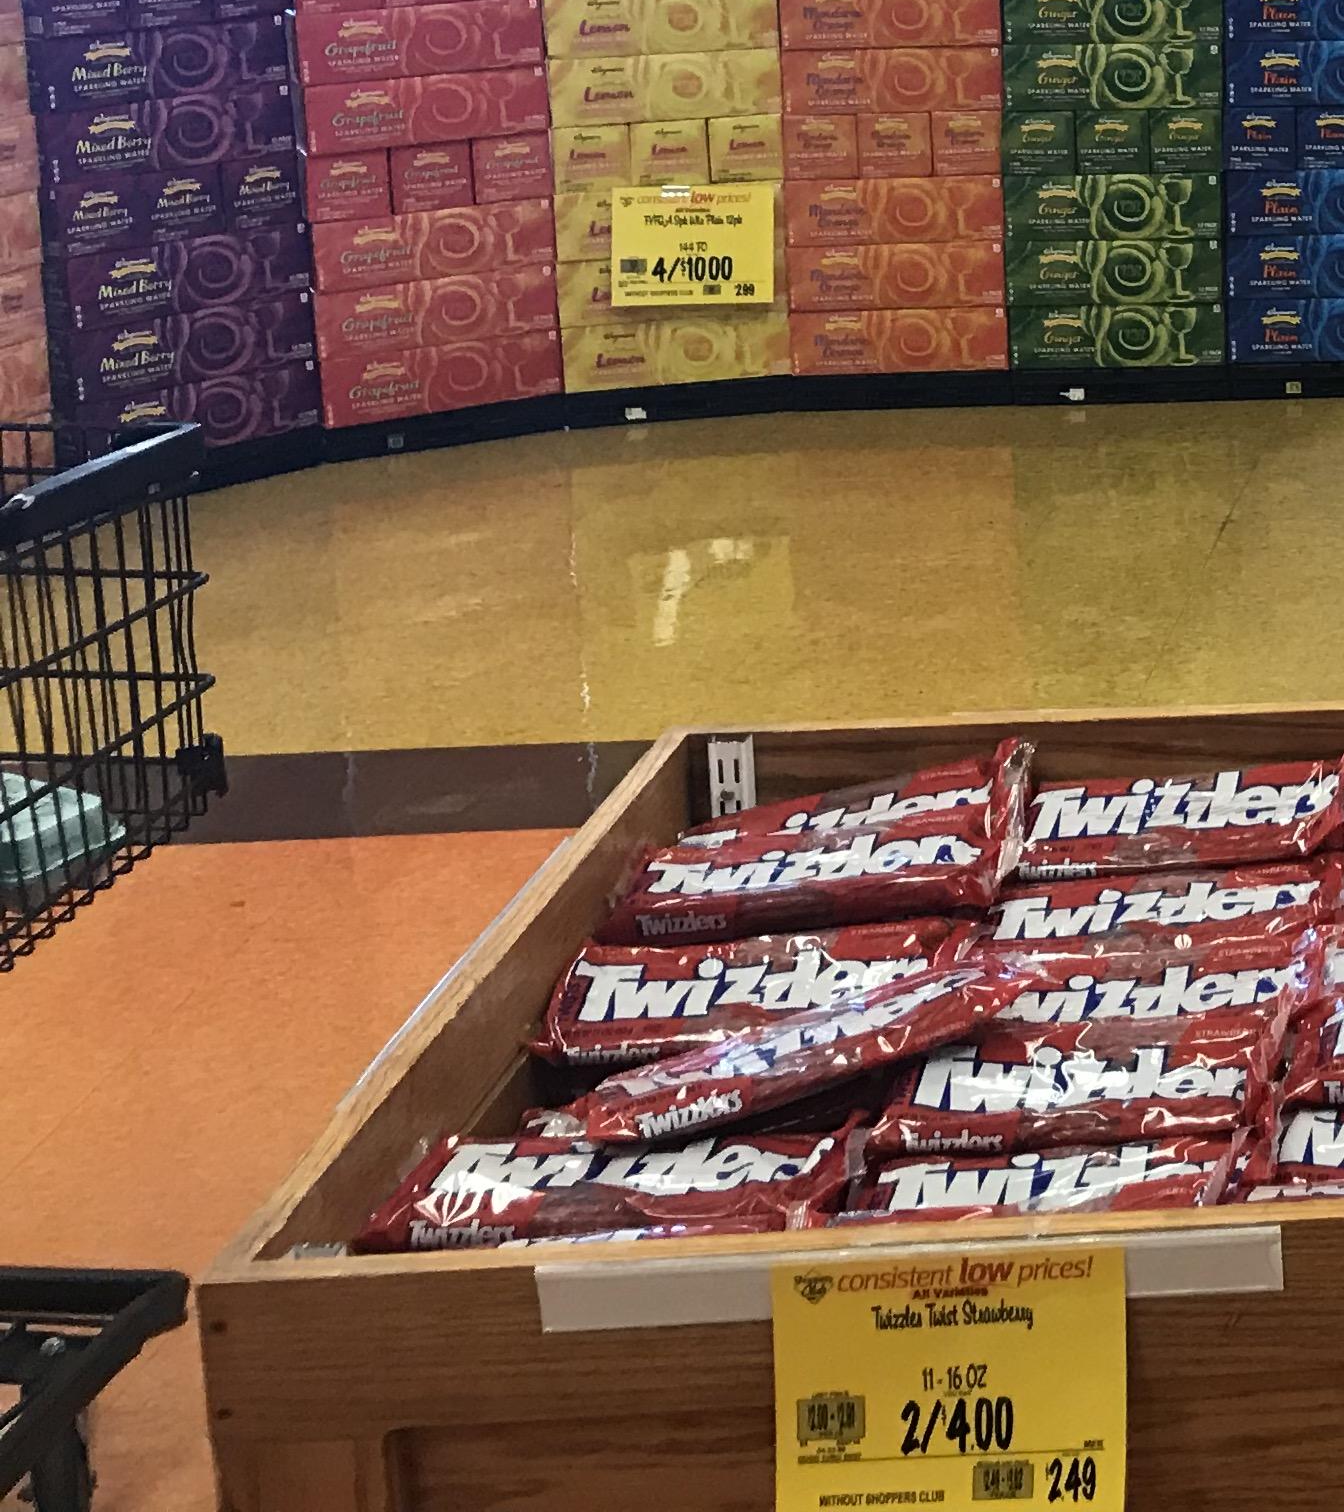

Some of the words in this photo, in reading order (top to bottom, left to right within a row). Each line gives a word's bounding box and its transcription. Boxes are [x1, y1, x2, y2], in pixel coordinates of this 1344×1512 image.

[690, 191, 715, 204] low
[636, 910, 727, 936] Twizzlers
[837, 1265, 955, 1293] consistent
[958, 1257, 1014, 1284] low
[1017, 1255, 1095, 1287] prices!
[924, 1301, 959, 1329] Twist
[962, 1298, 1034, 1330] Strawberry
[921, 1367, 935, 1392] 11
[946, 1365, 963, 1390] 16
[966, 1363, 988, 1389] OZ
[819, 1492, 864, 1507] WITHOUT
[865, 1490, 918, 1506] SHOPPERS
[919, 1489, 945, 1504] CLUB
